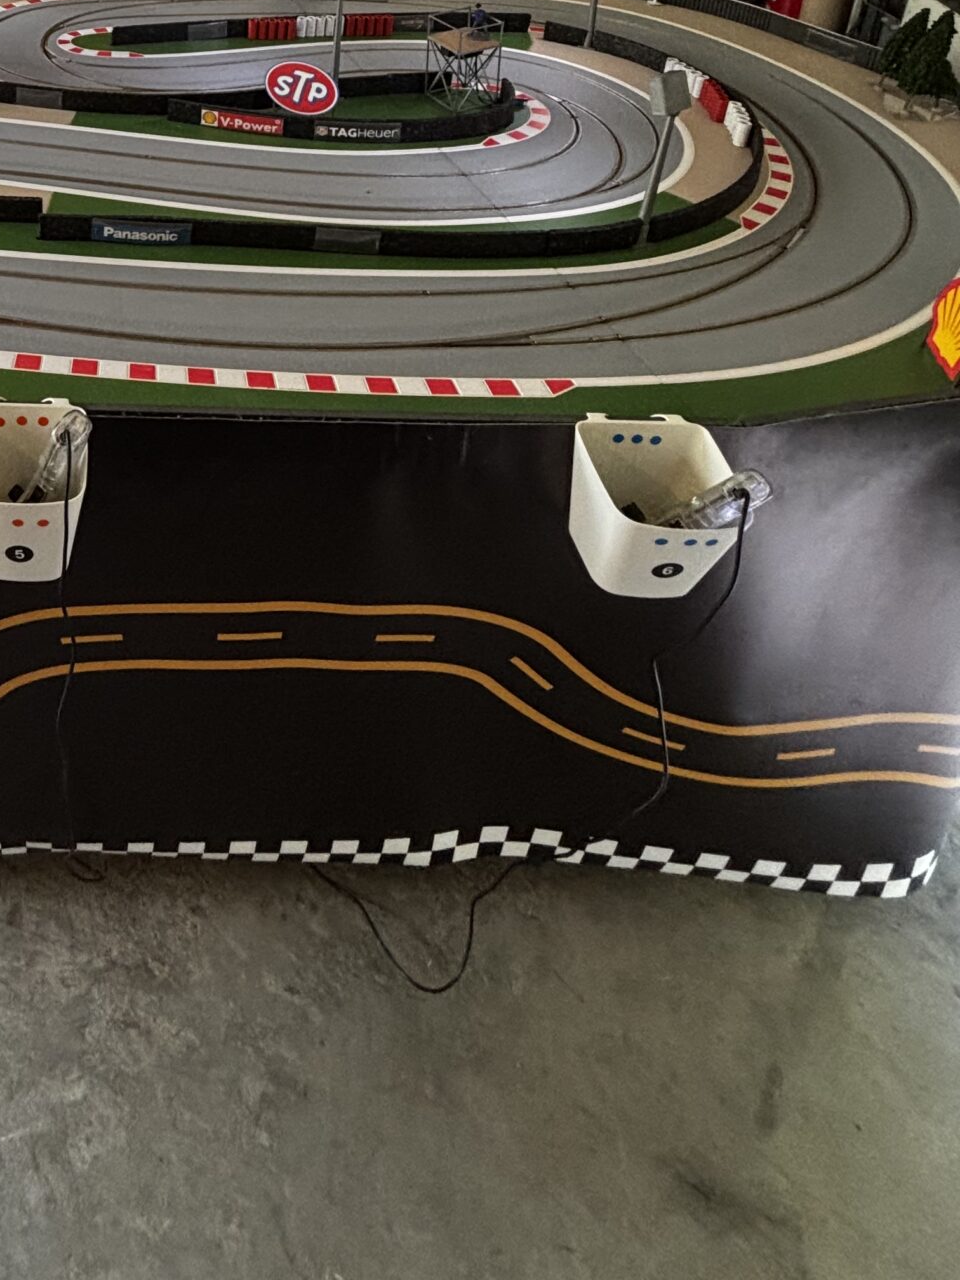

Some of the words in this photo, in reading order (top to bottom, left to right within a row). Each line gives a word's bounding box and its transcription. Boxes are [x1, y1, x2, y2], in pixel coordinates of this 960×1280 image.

[273, 73, 329, 103] STP
[220, 115, 278, 133] V-Power
[103, 226, 178, 242] Panasonic
[14, 549, 26, 560] 5
[661, 566, 674, 576] 6
